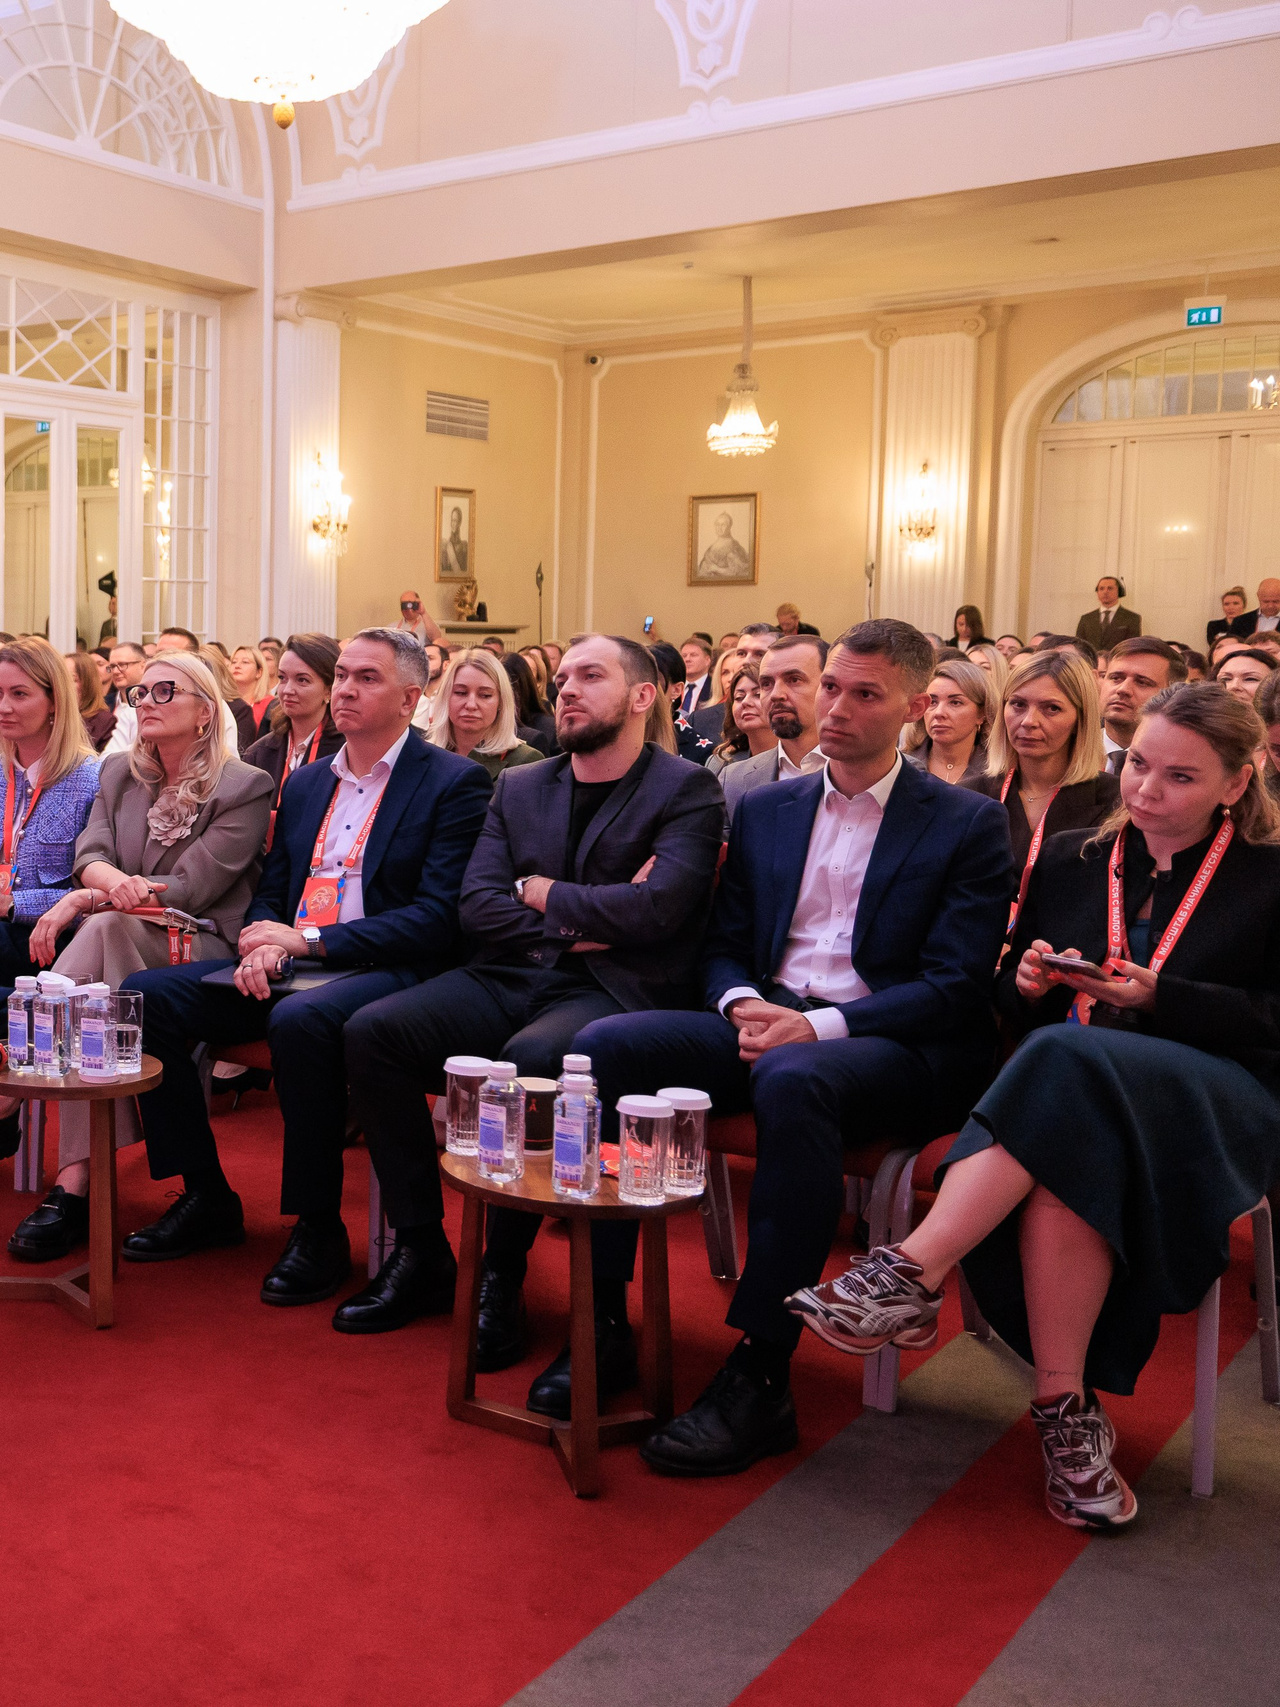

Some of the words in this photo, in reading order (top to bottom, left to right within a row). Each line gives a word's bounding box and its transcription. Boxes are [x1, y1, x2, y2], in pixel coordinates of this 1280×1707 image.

[1029, 836, 1040, 866] АСШТАБ
[1158, 910, 1188, 956] МАСШТАБ
[1183, 852, 1219, 911] НАЧИНАЕТСЯ
[1214, 844, 1223, 852] С
[1111, 907, 1121, 943] МАЛОГО
